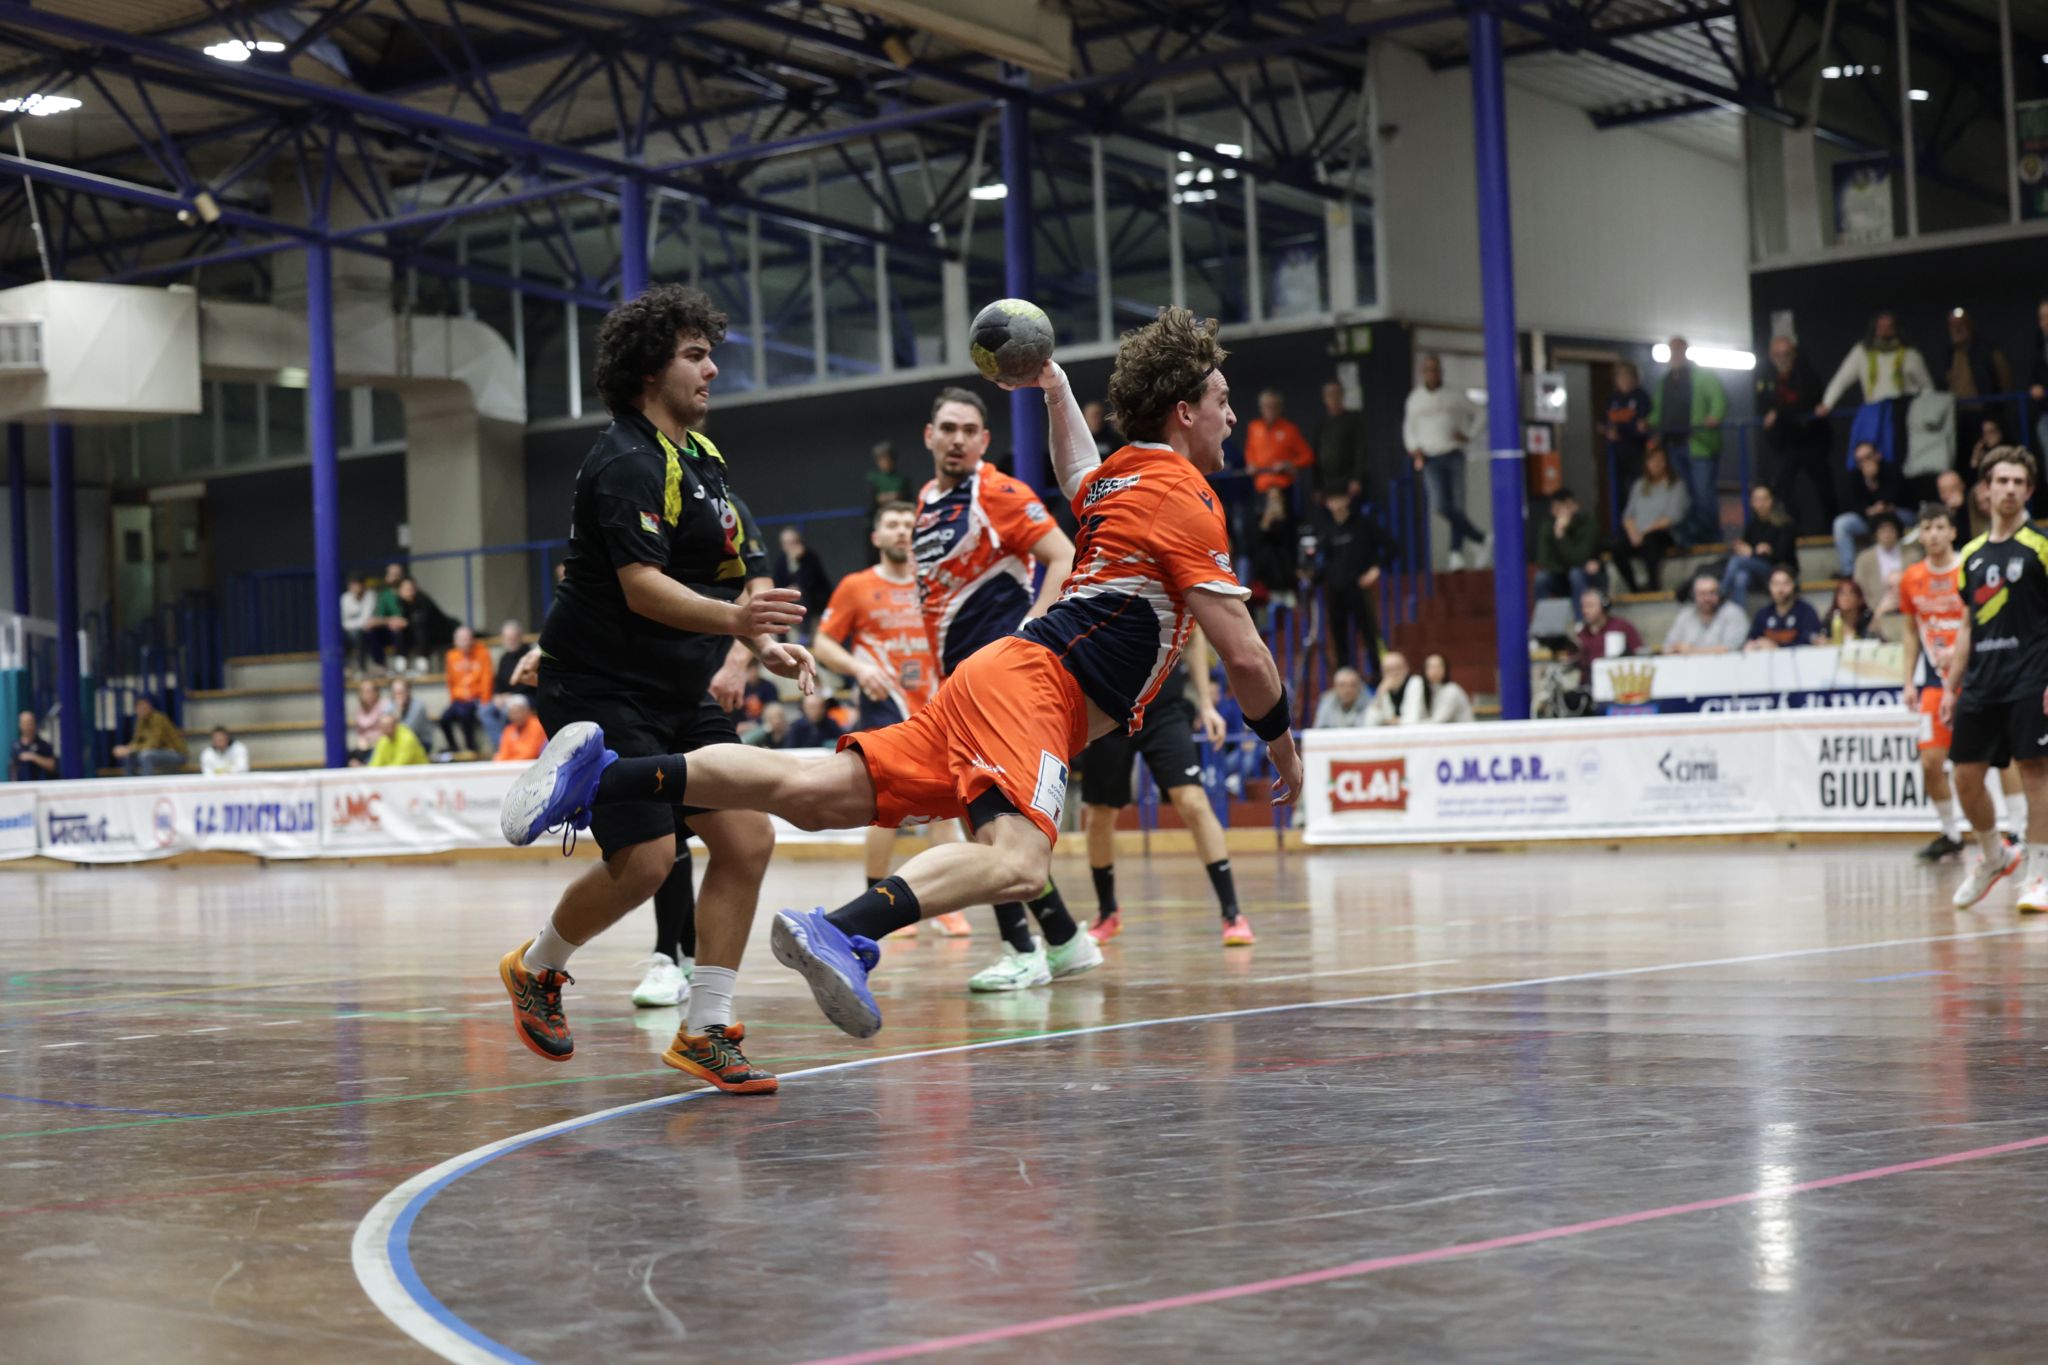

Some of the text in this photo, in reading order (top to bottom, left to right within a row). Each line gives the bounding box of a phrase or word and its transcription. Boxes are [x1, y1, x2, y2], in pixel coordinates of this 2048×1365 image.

[1986, 564, 2000, 588] 6
[1436, 756, 1549, 784] O.M.C.P.R.
[1336, 769, 1401, 804] CLAI
